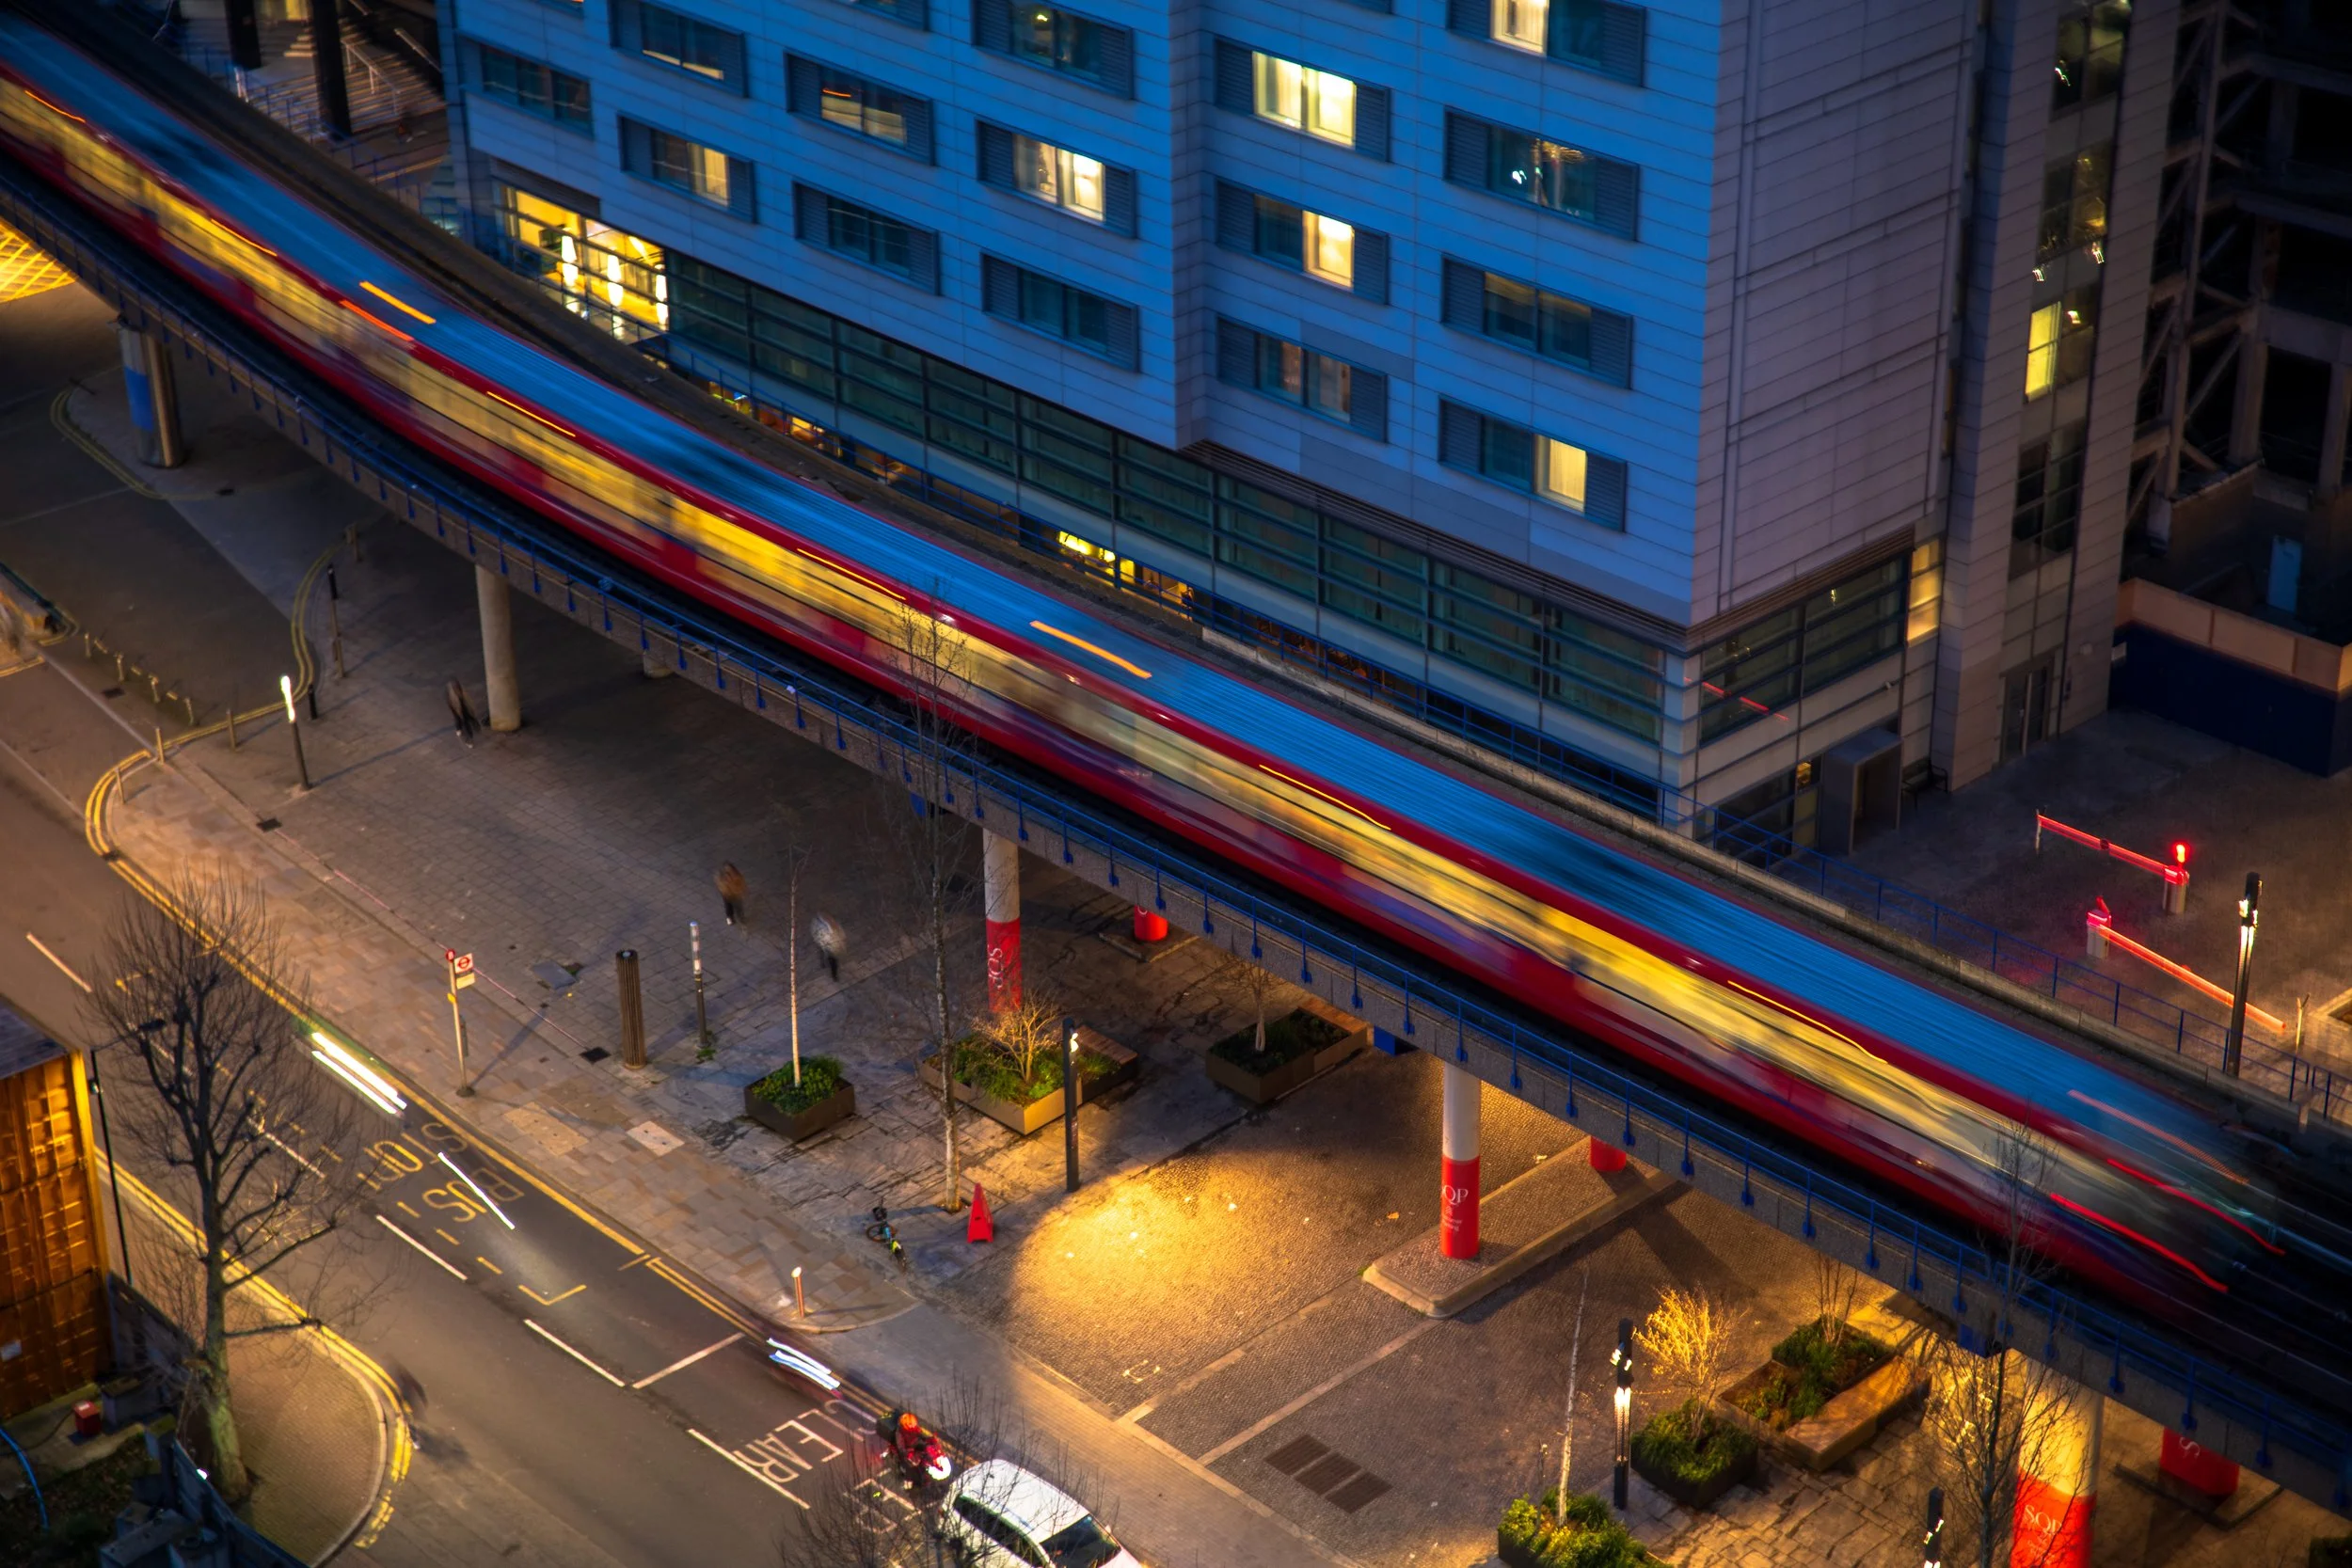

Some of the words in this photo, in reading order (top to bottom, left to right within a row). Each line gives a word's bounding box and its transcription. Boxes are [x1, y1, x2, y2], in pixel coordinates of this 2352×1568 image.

[421, 1167, 525, 1223] BUS
[1441, 1181, 1469, 1206] QP
[732, 1398, 878, 1483] CLEAR
